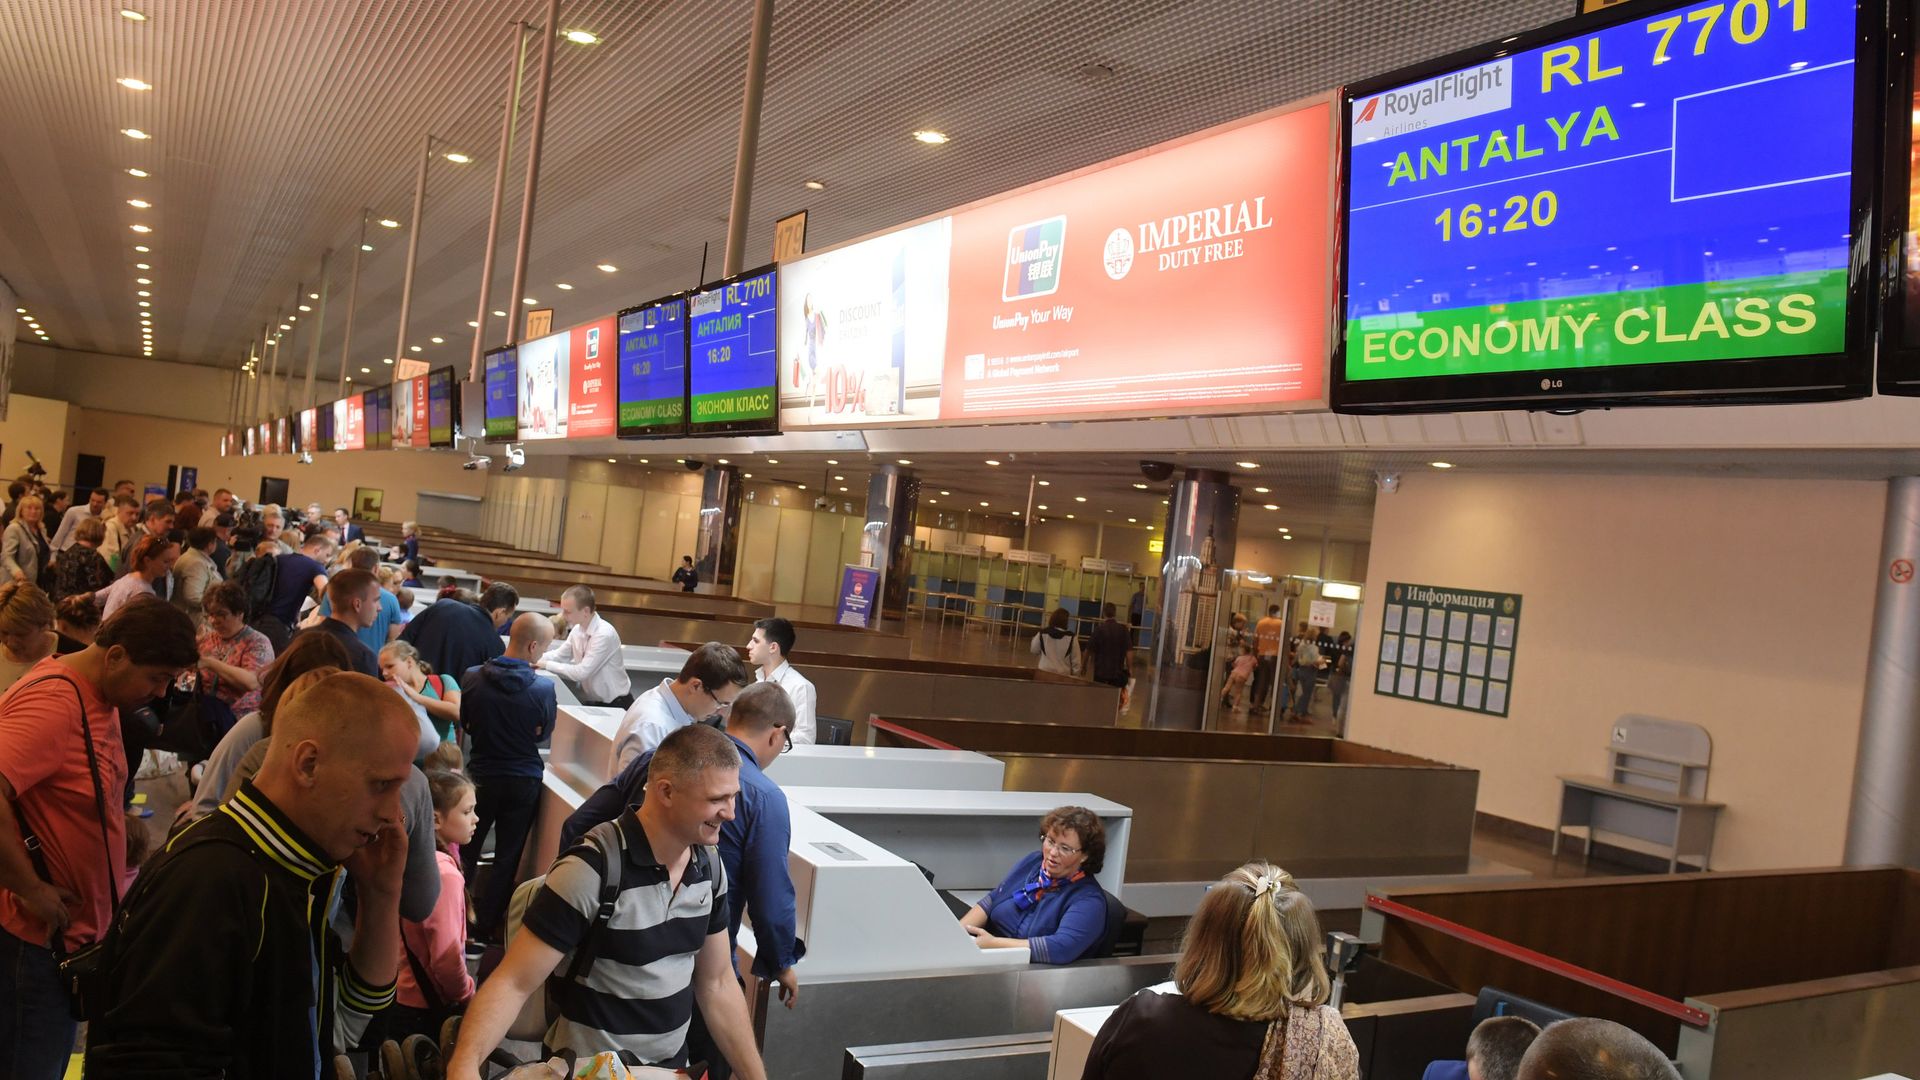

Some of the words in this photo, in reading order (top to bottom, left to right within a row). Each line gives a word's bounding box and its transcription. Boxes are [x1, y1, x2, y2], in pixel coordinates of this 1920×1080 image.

[1541, 37, 1623, 93] RL
[1646, 0, 1806, 66] 7701
[1384, 65, 1503, 116] RoyalFlight
[1383, 119, 1428, 137] Airlines
[1387, 105, 1620, 187] ANTALYA
[1138, 195, 1273, 254] IMPERIAL
[1435, 190, 1558, 242] 16:20
[778, 222, 802, 259] 179
[1010, 240, 1060, 265] UnionPay
[1158, 246, 1201, 272] DUTY
[1203, 239, 1244, 264] FREE
[1028, 260, 1054, 281] 银联
[726, 285, 741, 305] RL
[744, 275, 771, 300] 7701
[697, 313, 742, 337] АНТАЛИЯ
[839, 302, 882, 324] DISCOUNT
[993, 312, 1029, 332] UnionPay
[1030, 308, 1051, 324] Your
[1052, 305, 1074, 322] Way
[528, 316, 551, 338] 177
[1363, 312, 1599, 364] ECONOMY
[1614, 293, 1817, 345] CLASS
[625, 333, 659, 352] ANTALYA
[707, 346, 731, 364] 16:20
[824, 364, 866, 415] 10%
[1551, 379, 1563, 388] LG
[621, 405, 657, 420] ECONOMY
[657, 403, 683, 418] CLASS
[696, 399, 735, 416] ЭКОНОМ
[736, 394, 770, 412] КЛАСС
[1407, 586, 1496, 609] Информация
